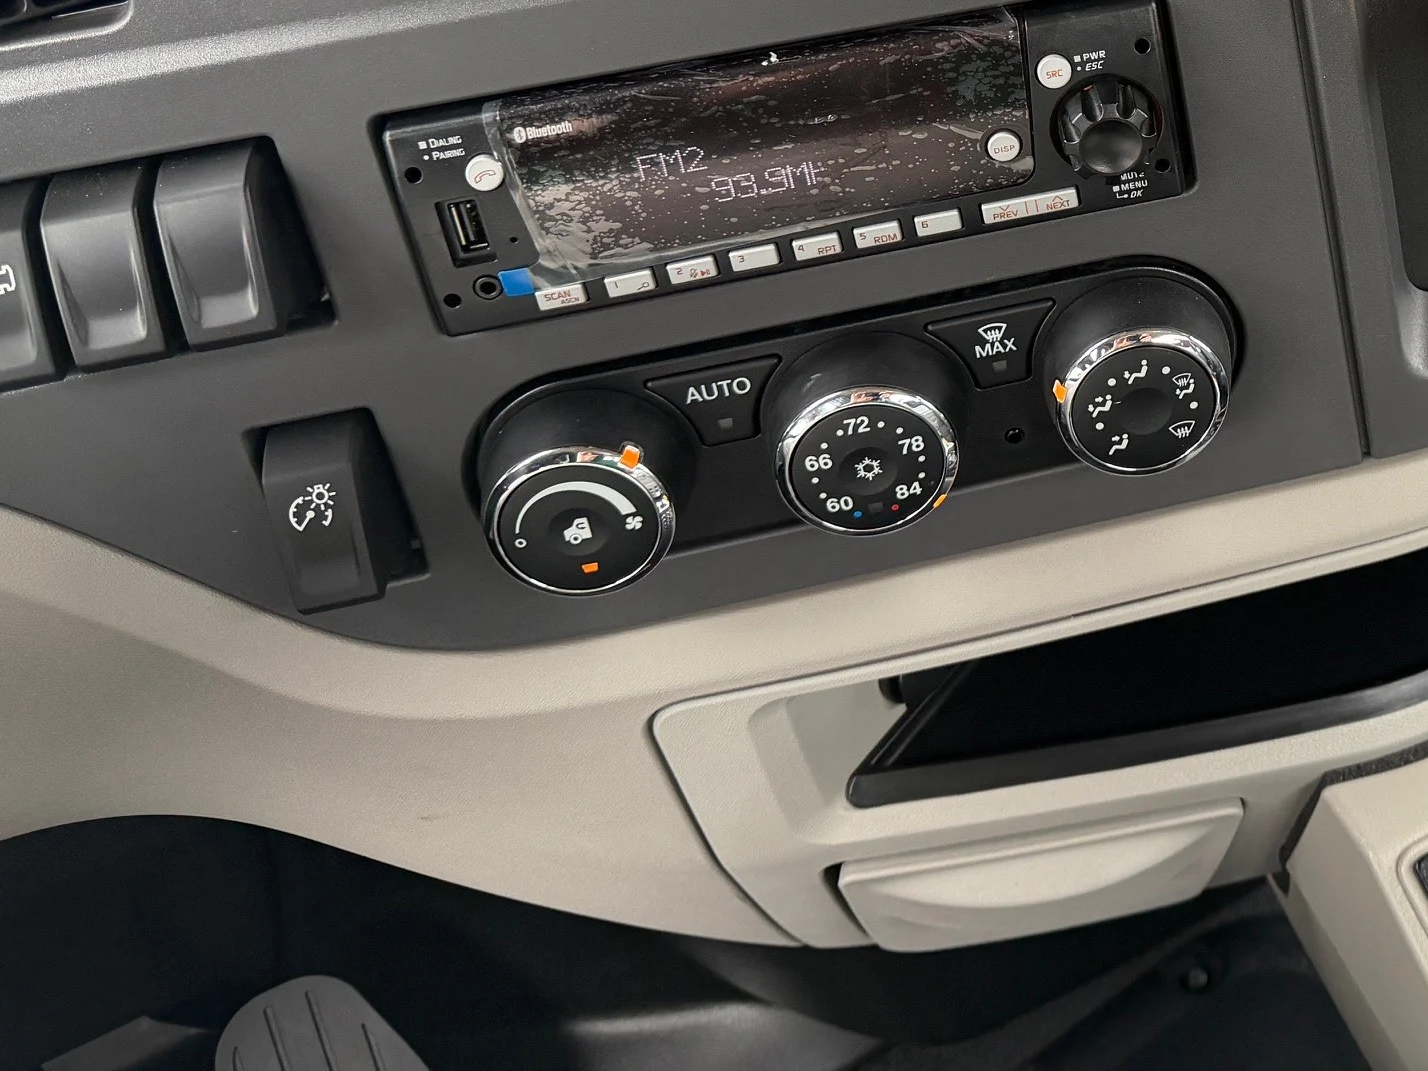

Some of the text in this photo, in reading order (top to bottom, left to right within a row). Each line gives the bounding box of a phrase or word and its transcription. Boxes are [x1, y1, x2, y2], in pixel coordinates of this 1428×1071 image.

[1083, 50, 1106, 61] PWR
[1085, 60, 1103, 71] ESC
[1046, 69, 1063, 79] SRC
[526, 121, 573, 140] Bluetooth
[993, 144, 1016, 155] DISP
[636, 146, 708, 181] FM2
[1120, 179, 1148, 191] MENU
[1130, 189, 1143, 199] OK
[1046, 199, 1070, 211] NEXT
[993, 210, 1018, 221] PREV
[921, 220, 929, 229] 6
[874, 232, 898, 244] RDM
[817, 245, 837, 256] RPT
[737, 255, 745, 263] 3
[543, 290, 571, 302] SCAN
[974, 337, 1017, 359] MAX
[685, 376, 752, 404] AUTO
[842, 416, 871, 435] 72
[898, 435, 925, 455] 78
[804, 453, 833, 472] 66
[895, 481, 922, 500] 84
[826, 495, 854, 513] 60
